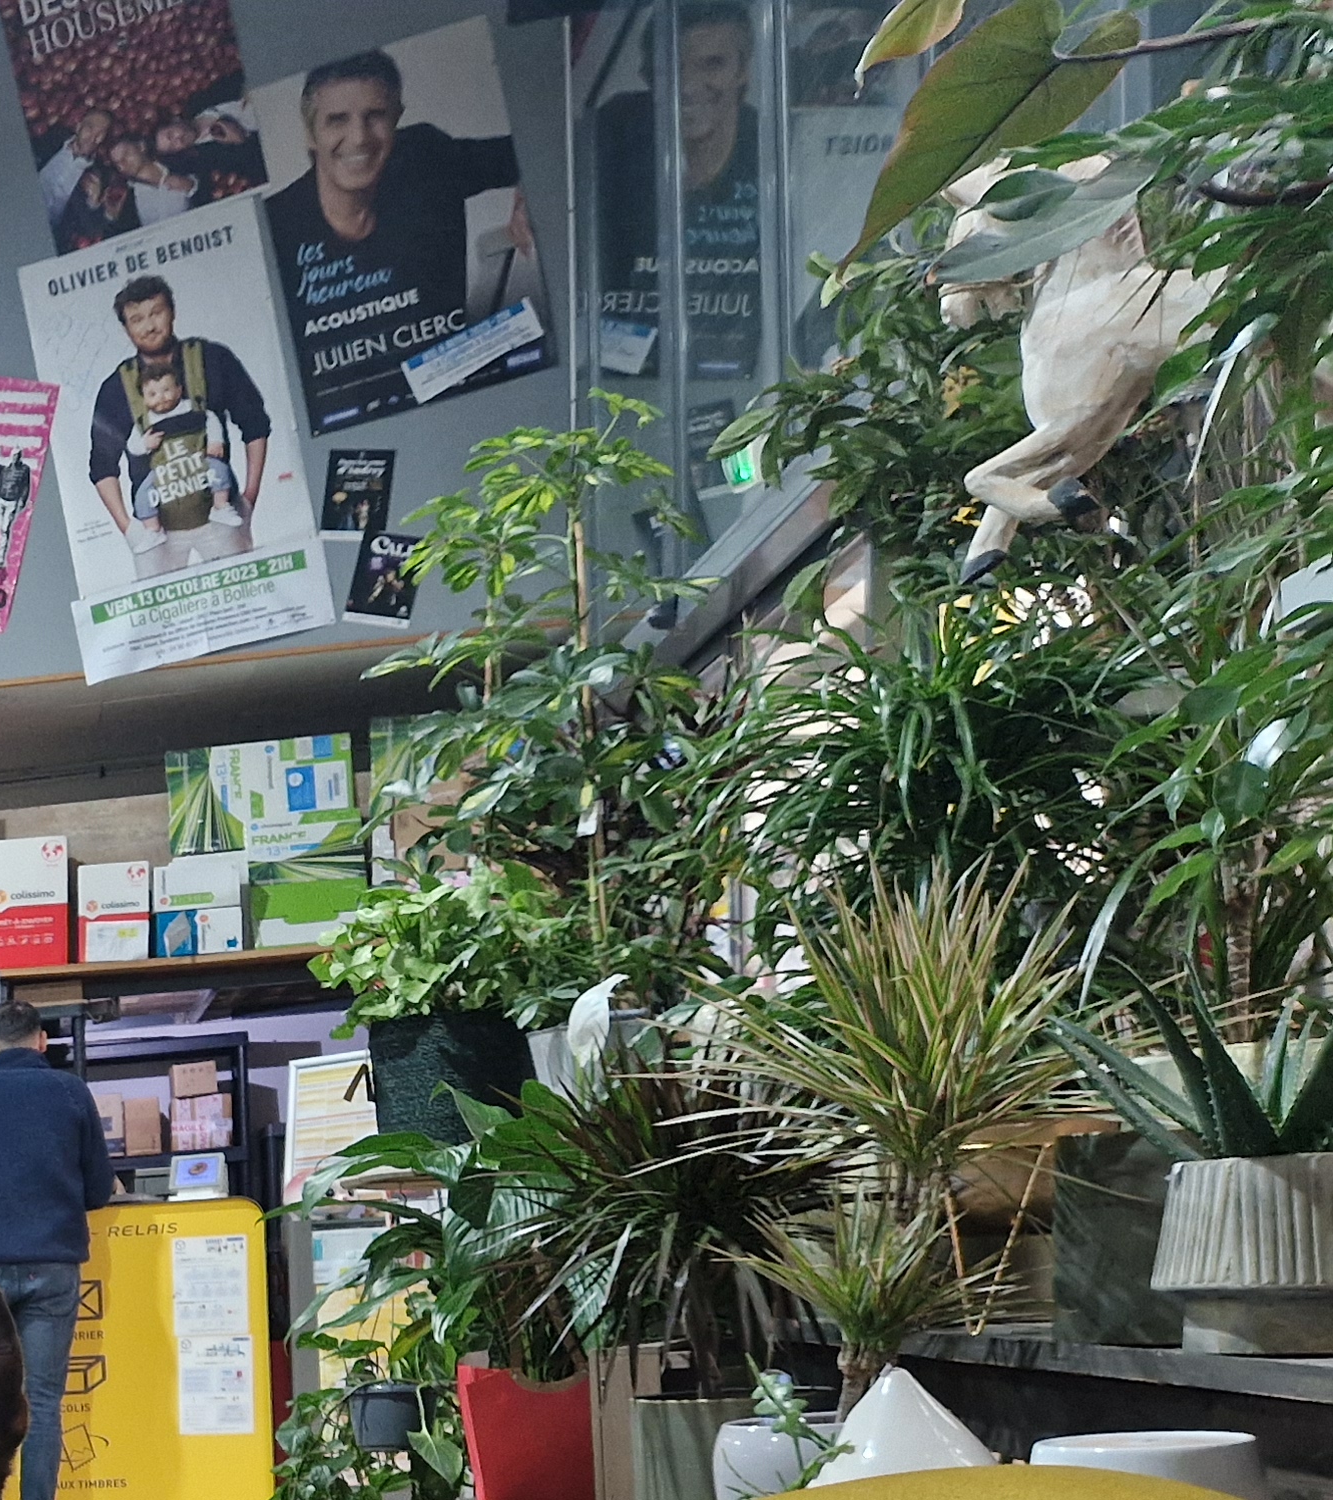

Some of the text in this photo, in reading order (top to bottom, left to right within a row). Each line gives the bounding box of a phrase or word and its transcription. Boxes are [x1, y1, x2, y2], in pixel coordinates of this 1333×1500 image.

[47, 225, 233, 297] OLIVIER DE BENOIST
[304, 288, 420, 337] ACOUSTIQUE
[312, 308, 467, 376] JULIEN CLERC
[162, 440, 189, 461] LE
[155, 451, 204, 486] PETIT
[147, 468, 223, 508] DERNIER
[139, 592, 154, 608] 13
[221, 562, 259, 585] 2023
[268, 555, 295, 575] 21H
[130, 610, 147, 628] La
[149, 594, 209, 624] Cigalière
[223, 579, 277, 604] Bollène
[251, 830, 307, 846] FRANCE
[10, 889, 55, 901] colissimo
[100, 899, 140, 910] colissimo
[107, 1222, 179, 1238] RELAIS
[72, 1330, 104, 1342] RRIER
[55, 1478, 128, 1491] AUX TIMBRES
